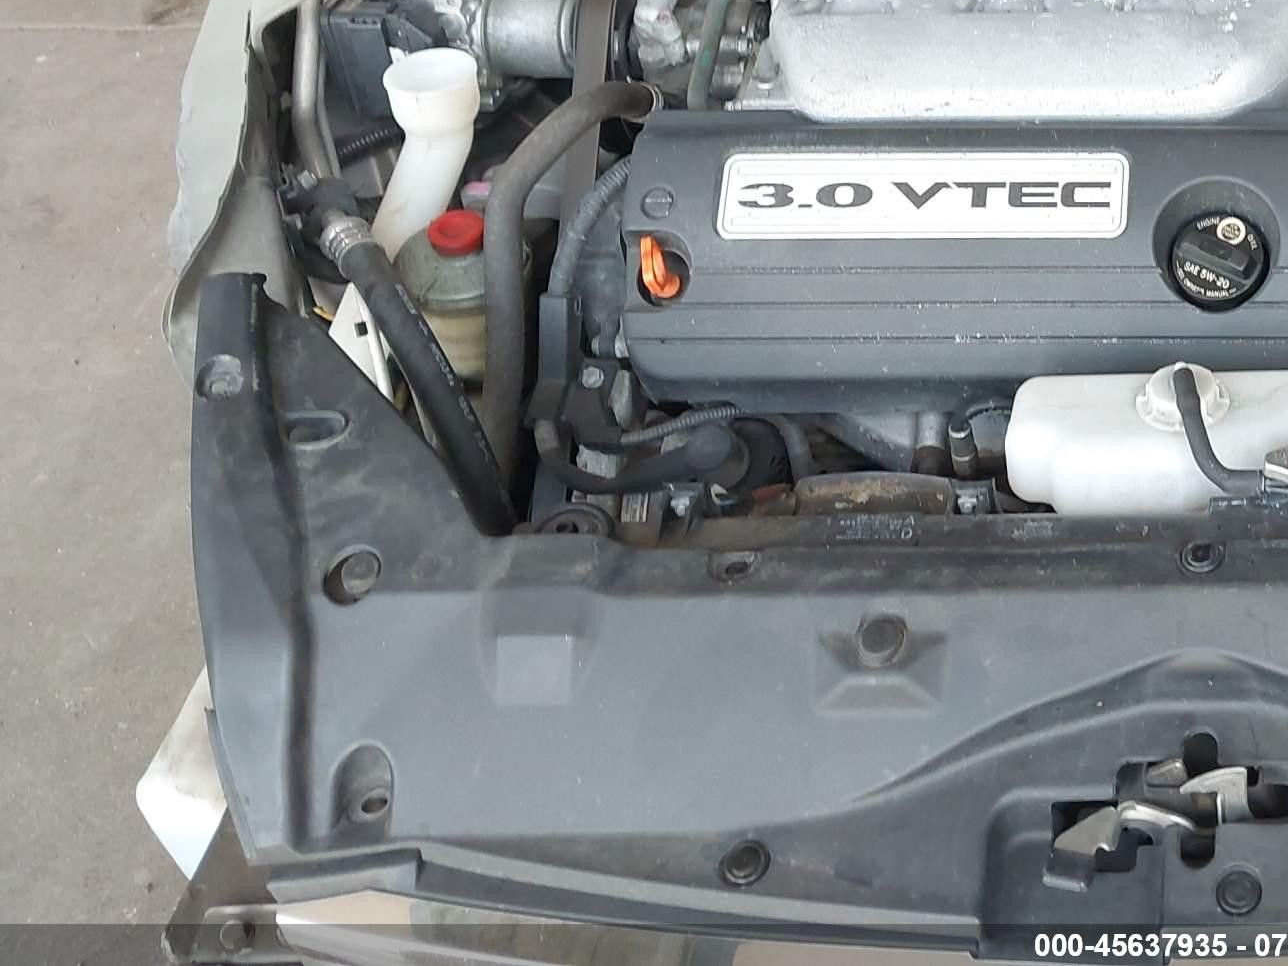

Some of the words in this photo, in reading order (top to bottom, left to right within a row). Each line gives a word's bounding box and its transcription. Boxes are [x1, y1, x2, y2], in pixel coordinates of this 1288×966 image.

[737, 182, 874, 209] 3.0
[891, 181, 1112, 210] VTEC
[1183, 261, 1200, 276] SAE
[1200, 268, 1230, 289] 5W-20
